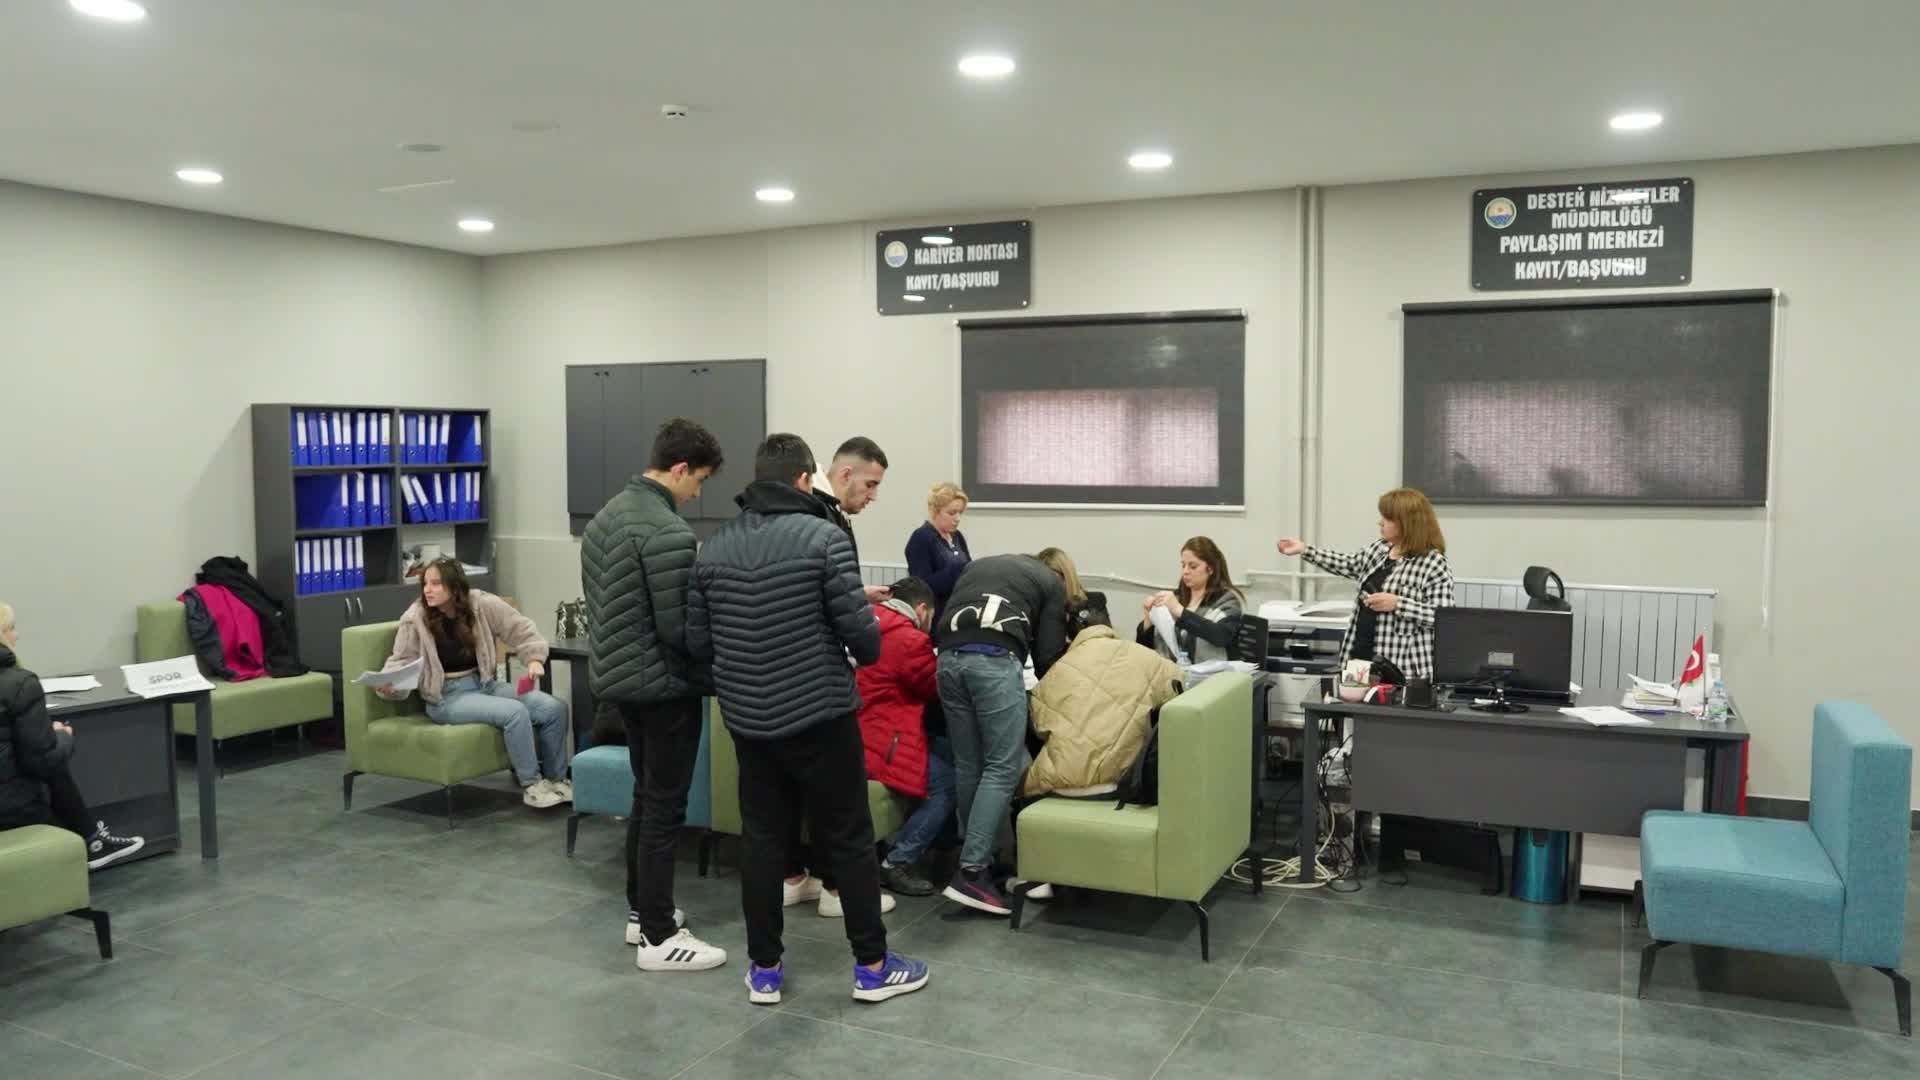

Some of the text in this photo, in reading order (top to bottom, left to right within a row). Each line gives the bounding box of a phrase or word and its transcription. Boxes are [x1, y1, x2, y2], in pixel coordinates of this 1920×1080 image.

[1527, 190, 1585, 210] DESTEK
[1551, 205, 1653, 229] MÜDÜRLÜĞÜ
[1500, 225, 1664, 254] PAYLAŞIM MERKEZİ
[914, 242, 1018, 265] KARİYER NOKTASI
[906, 270, 999, 292] KAYIT/BAŞVURU
[149, 671, 182, 684] SPOR
